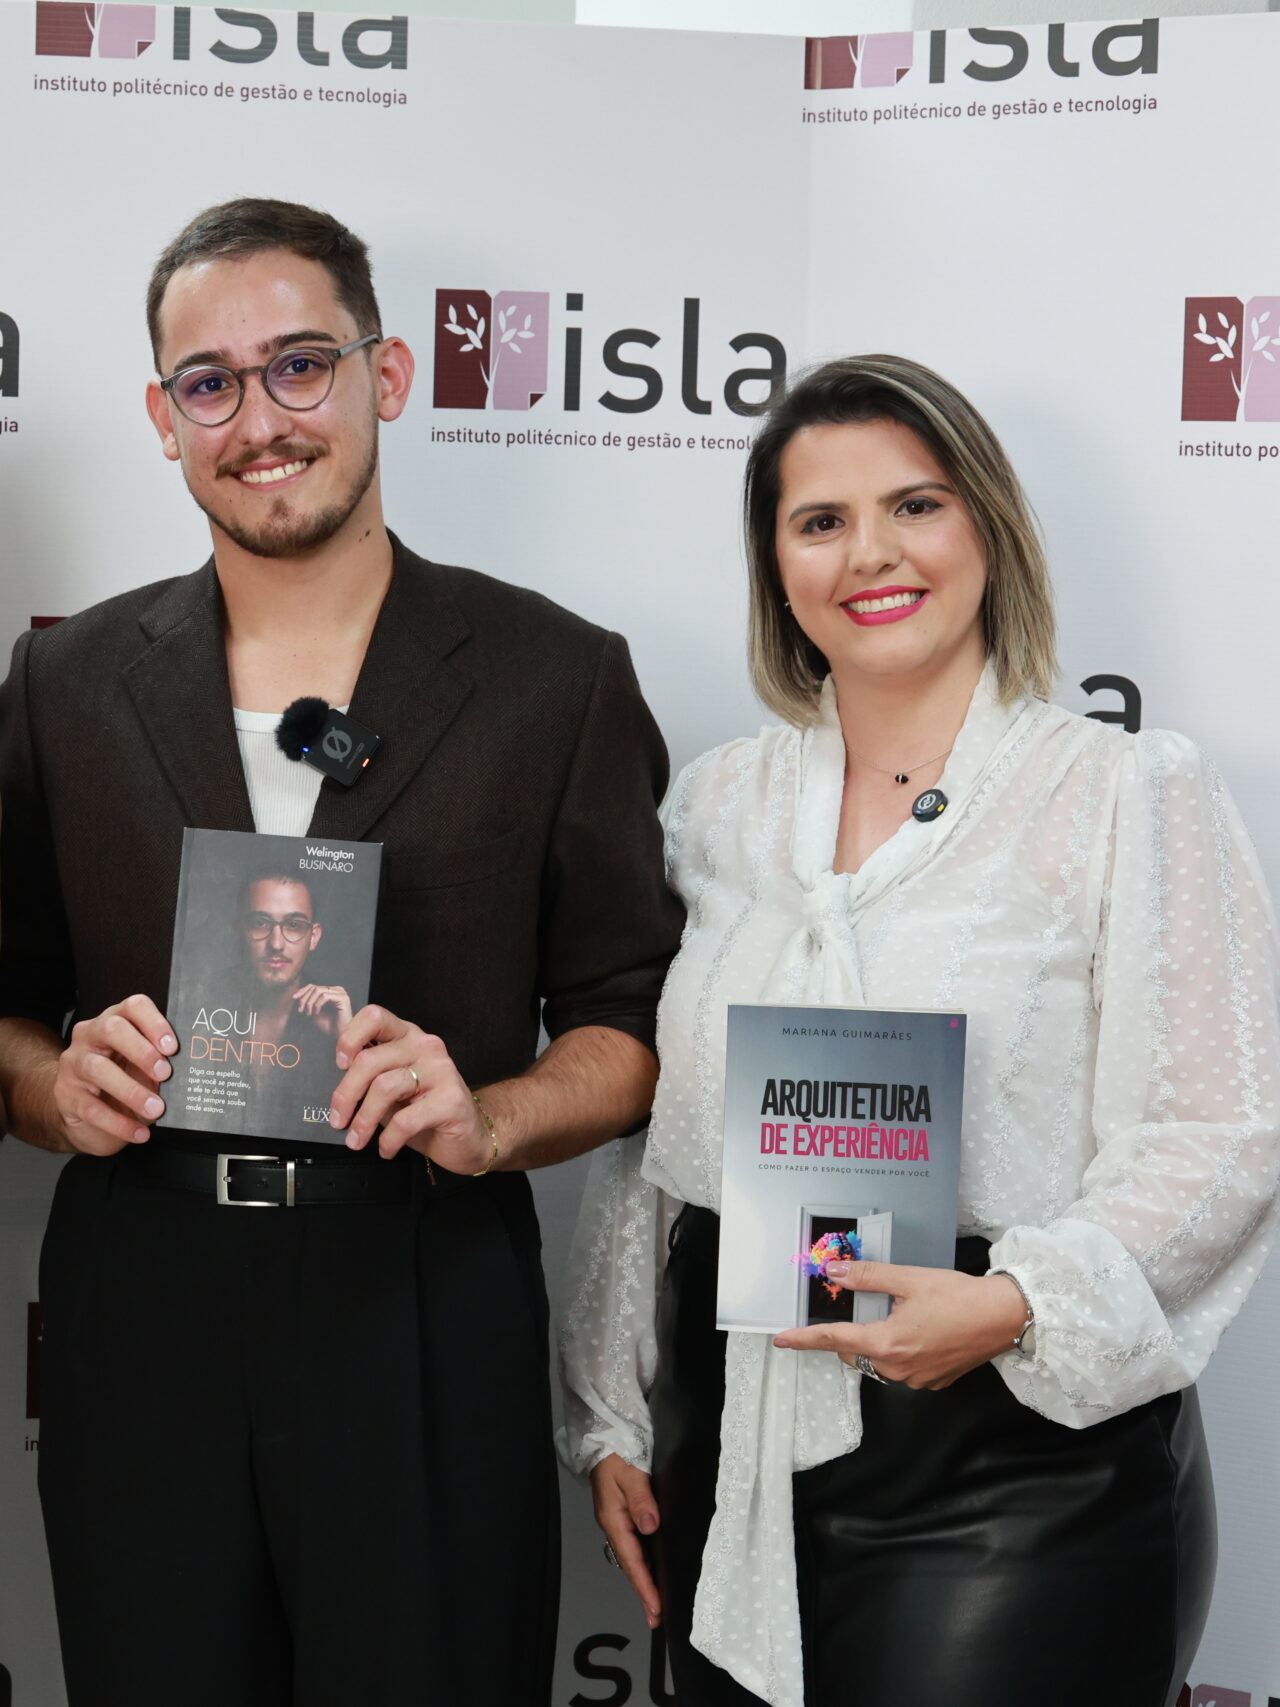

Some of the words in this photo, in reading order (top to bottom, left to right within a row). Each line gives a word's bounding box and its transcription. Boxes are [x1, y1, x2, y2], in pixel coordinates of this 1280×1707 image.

[34, 74, 107, 93] instituto
[113, 78, 208, 97] politécnico
[214, 82, 235, 98] de
[240, 84, 298, 102] gestão
[303, 89, 313, 102] e
[319, 87, 408, 108] tecnologia
[802, 107, 869, 124] instituto
[873, 103, 962, 125] politécnico
[967, 101, 987, 118] de
[992, 98, 1048, 120] gestão
[1053, 100, 1063, 114] e
[1067, 94, 1158, 114] tecnologia
[564, 293, 787, 418] isla
[431, 427, 501, 445] instituto
[506, 429, 597, 448] politécnico
[602, 432, 621, 448] de
[627, 433, 681, 451] gestão
[687, 438, 696, 450] e
[1179, 440, 1252, 457] instituto
[306, 846, 354, 861] Welington
[299, 858, 354, 873] BUSINARO
[192, 1008, 256, 1037] AQUI
[782, 1027, 837, 1038] MARIANA
[842, 1029, 912, 1041] GUIMARÃES
[190, 1036, 301, 1069] DENTRO
[190, 1067, 204, 1076] Diga
[216, 1070, 240, 1078] espelho
[211, 1087, 225, 1095] dirá
[227, 1080, 251, 1089] perdeu,
[227, 1098, 246, 1106] soube
[761, 1079, 931, 1123] ARQUITETURA
[760, 1123, 788, 1155] DE
[793, 1122, 929, 1161] EXPERIÊNCIA
[821, 1166, 852, 1174] ESPAÇO
[909, 1169, 930, 1177] VOCÊ
